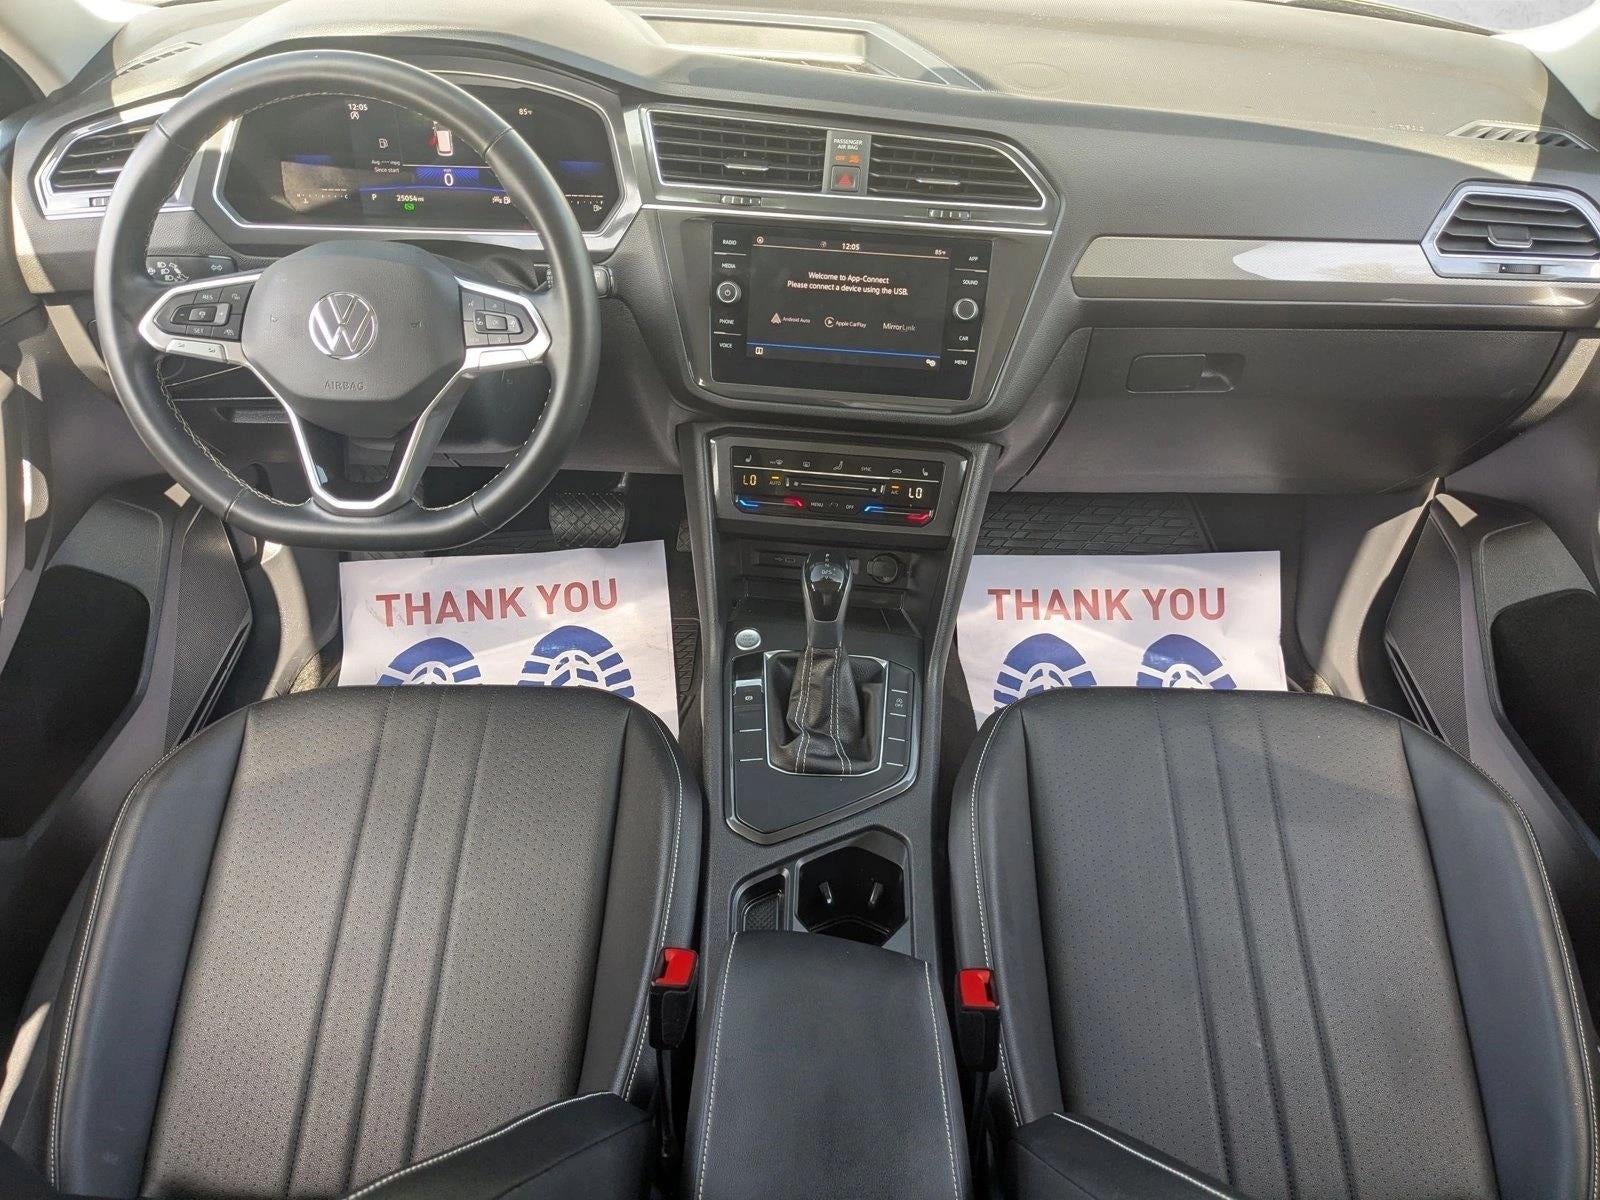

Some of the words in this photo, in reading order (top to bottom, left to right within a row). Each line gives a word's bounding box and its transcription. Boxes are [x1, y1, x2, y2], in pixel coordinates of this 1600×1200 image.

[348, 103, 368, 111] 12:05
[444, 173, 454, 187] 0
[842, 243, 860, 251] 12:05
[721, 262, 737, 270] MEDIA
[808, 271, 839, 281] Welcome
[847, 274, 889, 285] App-Connect
[787, 280, 808, 290] Please
[808, 283, 835, 292] connect
[840, 284, 862, 293] device
[862, 286, 881, 297] using
[881, 287, 893, 296] the
[893, 288, 909, 297] USB.
[848, 321, 867, 329] CarPlay
[882, 322, 916, 332] MirrorLink
[323, 381, 364, 391] AIRBAG
[375, 586, 526, 628] THANK
[536, 577, 618, 615] YOU
[987, 588, 1133, 621] THANK
[1141, 587, 1226, 621] YOU
